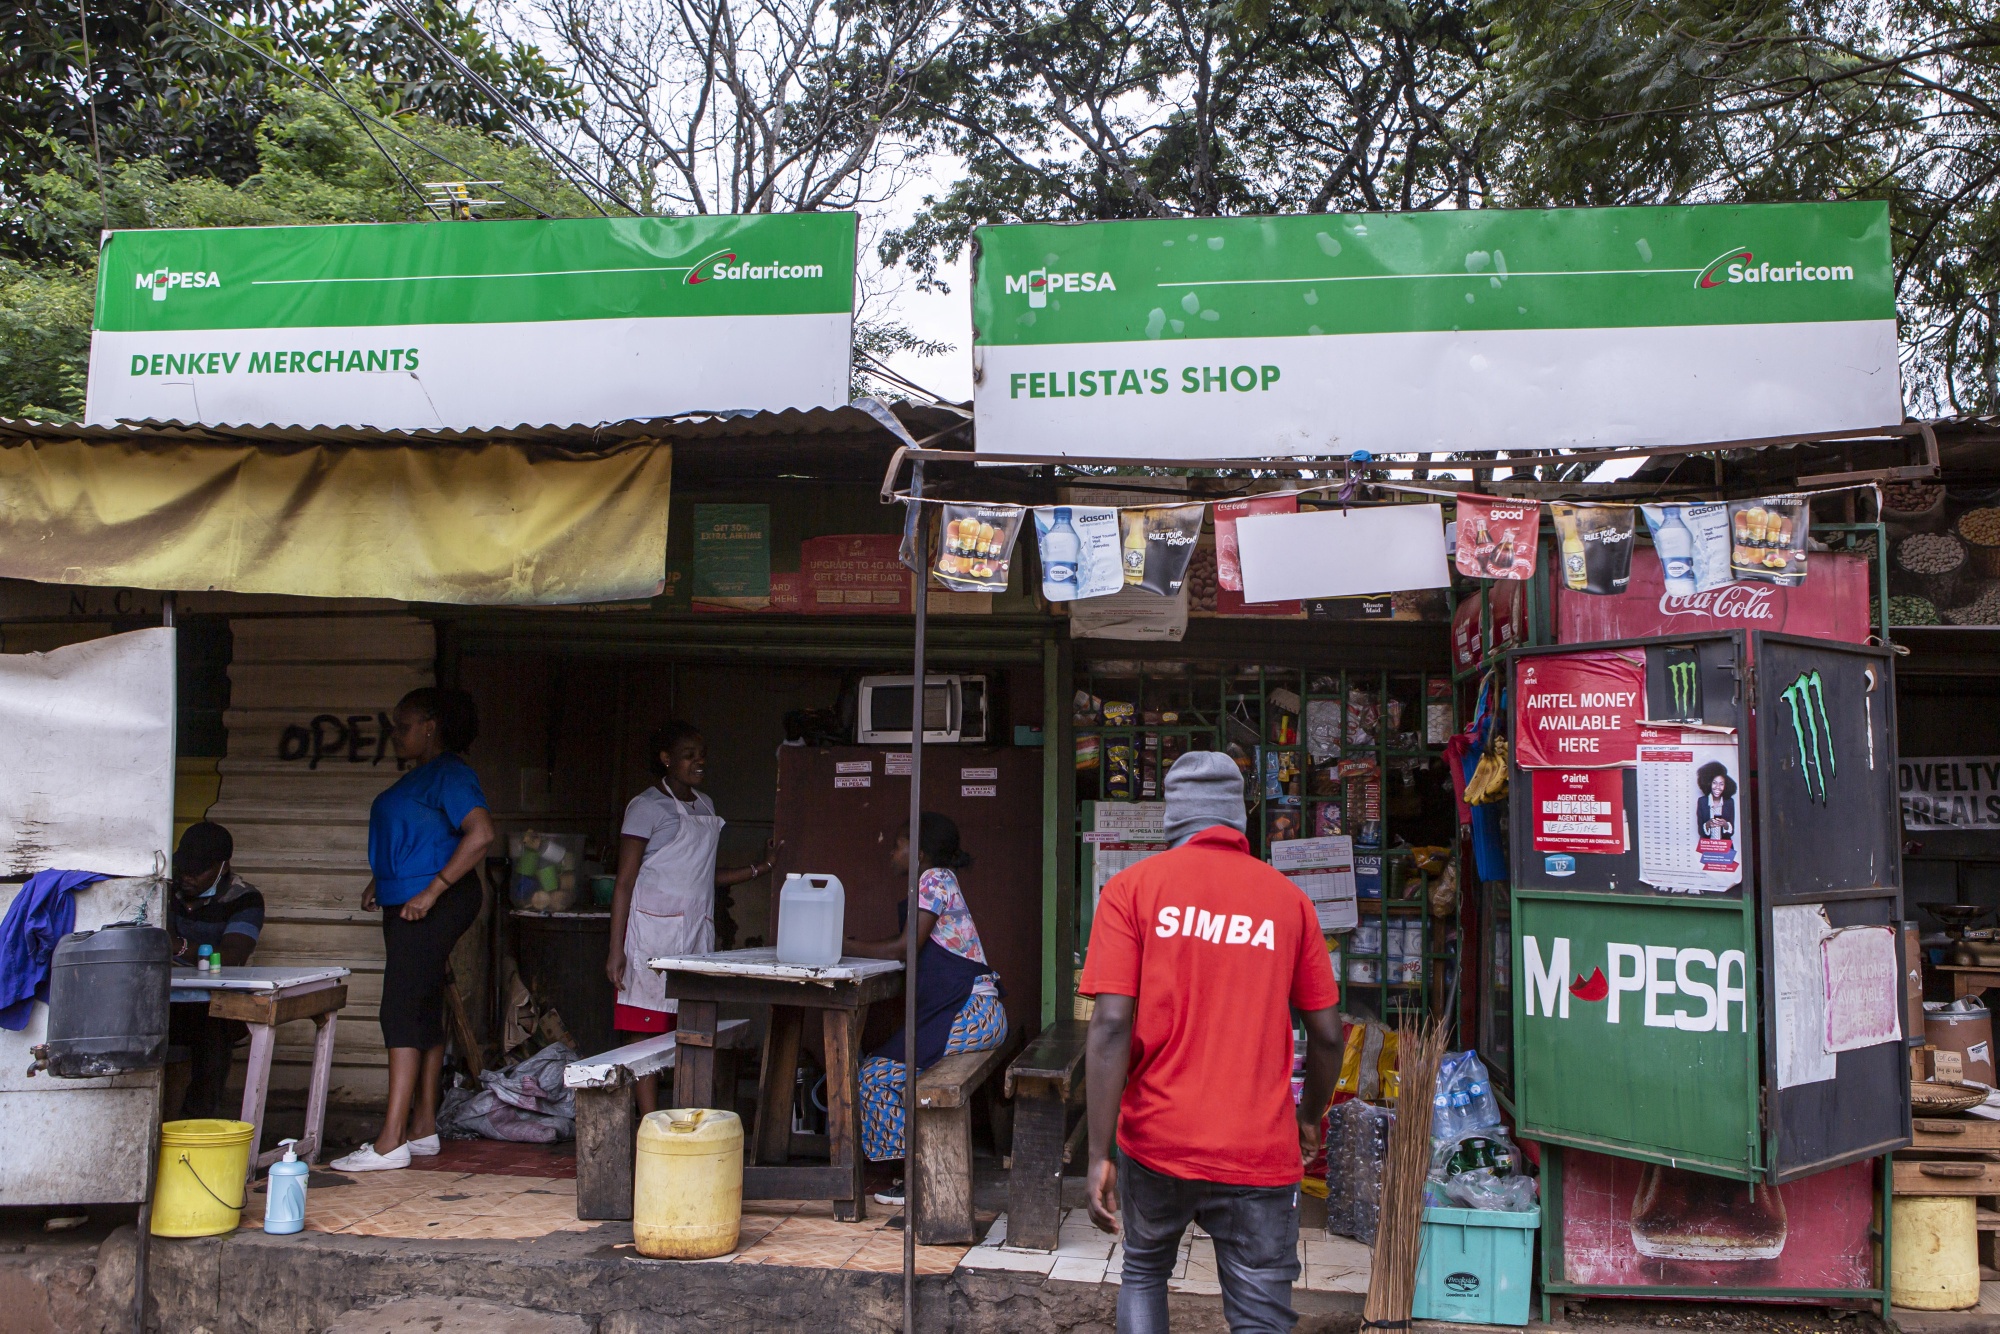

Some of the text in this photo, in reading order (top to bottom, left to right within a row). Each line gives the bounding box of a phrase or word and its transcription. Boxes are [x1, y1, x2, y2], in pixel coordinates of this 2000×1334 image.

[713, 261, 823, 280] Safaricom
[1727, 261, 1854, 283] Safaricom
[130, 347, 419, 376] DENKEV MERCHANTS
[1010, 365, 1281, 399] FELISTA'S SHOP
[1079, 511, 1114, 523] dasani
[1491, 509, 1524, 521] good
[1148, 532, 1166, 541] RULE
[1165, 530, 1183, 542] YOUR
[1584, 532, 1600, 541] RULE
[1600, 527, 1616, 540] YOUR
[810, 560, 906, 570] UPGRADE TO 4G AND
[814, 573, 903, 582] GET 2GB FREE DATA
[770, 583, 791, 592] ARD
[774, 595, 798, 603] HERE
[1659, 585, 1775, 619] Coca-Cola
[1527, 692, 1637, 709] AIRTEL MONEY
[1539, 714, 1622, 731] AVAILABLE
[1640, 730, 1658, 738] airtel
[1559, 737, 1601, 753] HERE
[1569, 774, 1590, 783] airtel
[1354, 856, 1382, 865] TRUST
[1155, 906, 1275, 951] SIMBA
